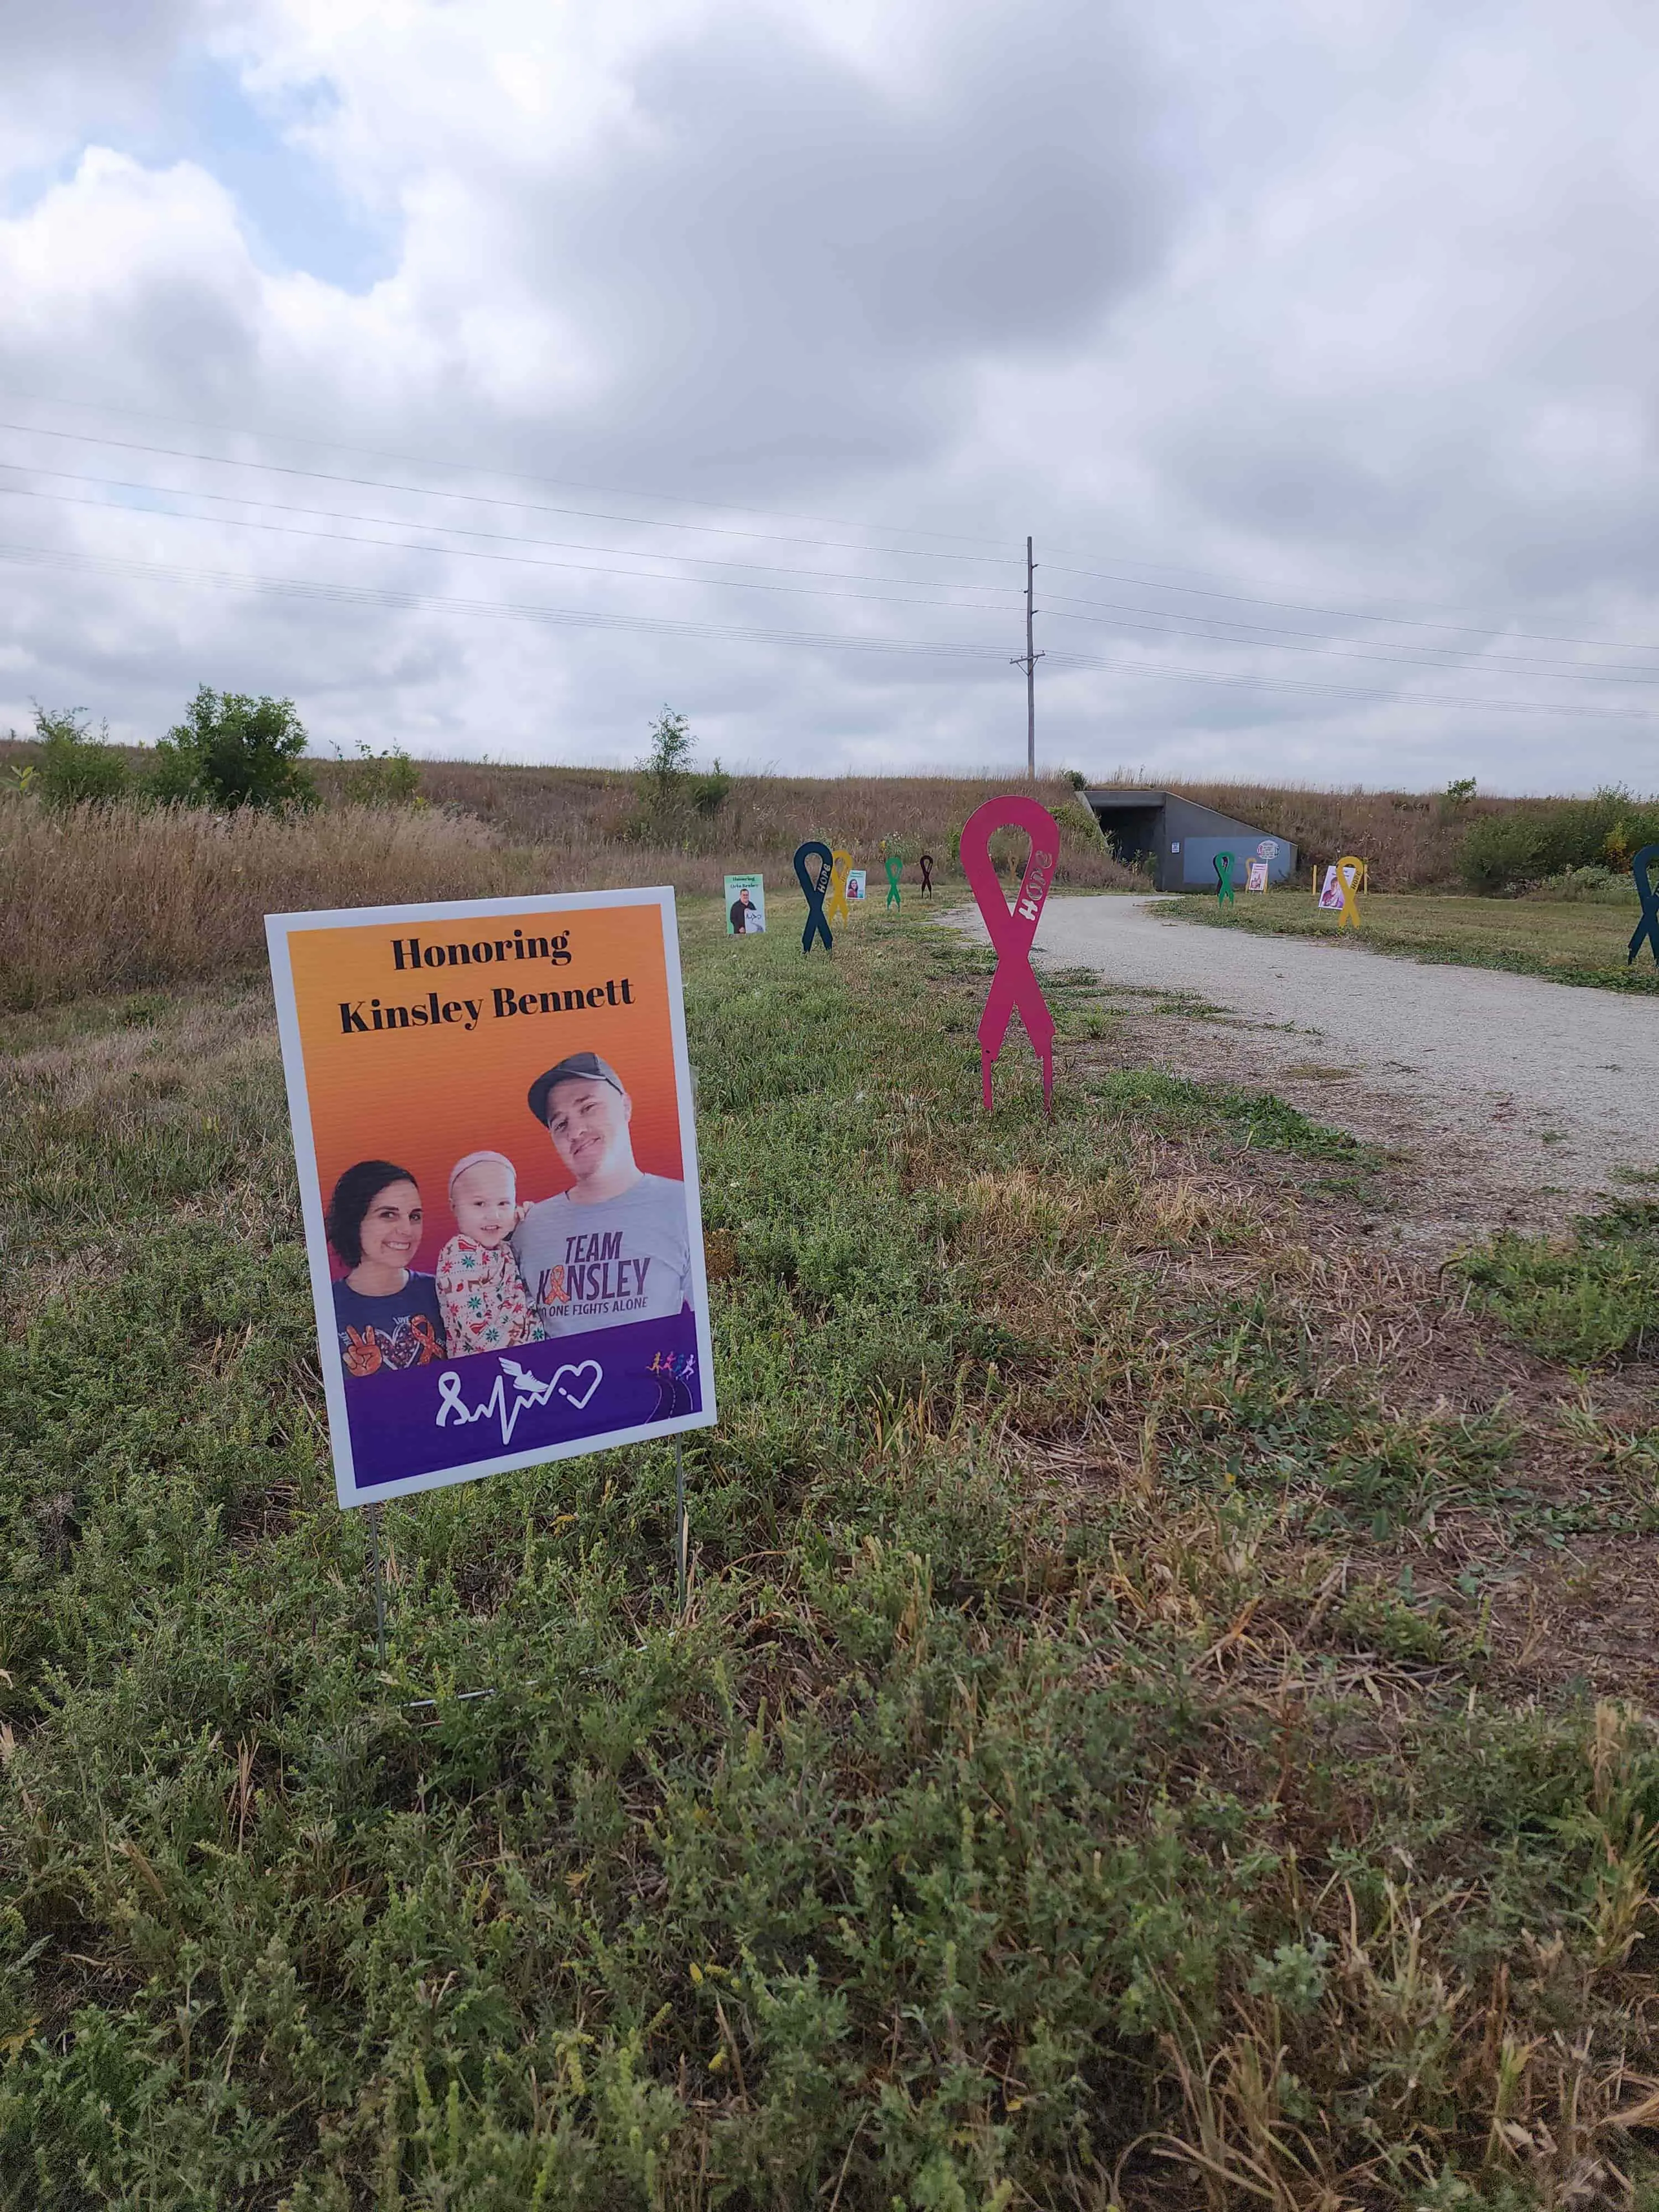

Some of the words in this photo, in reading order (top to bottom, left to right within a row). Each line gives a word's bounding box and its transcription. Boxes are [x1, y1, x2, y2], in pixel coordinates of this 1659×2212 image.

[391, 929, 572, 969] Honoring
[338, 992, 483, 1035] Kinsley
[492, 978, 635, 1018] Bennett
[565, 1231, 623, 1264] TEAM
[537, 1258, 651, 1305] KNSLEY
[393, 1315, 411, 1325] LOVE
[549, 1305, 570, 1316] ONE
[573, 1302, 609, 1315] FIGHTS
[612, 1297, 648, 1312] ALONE
